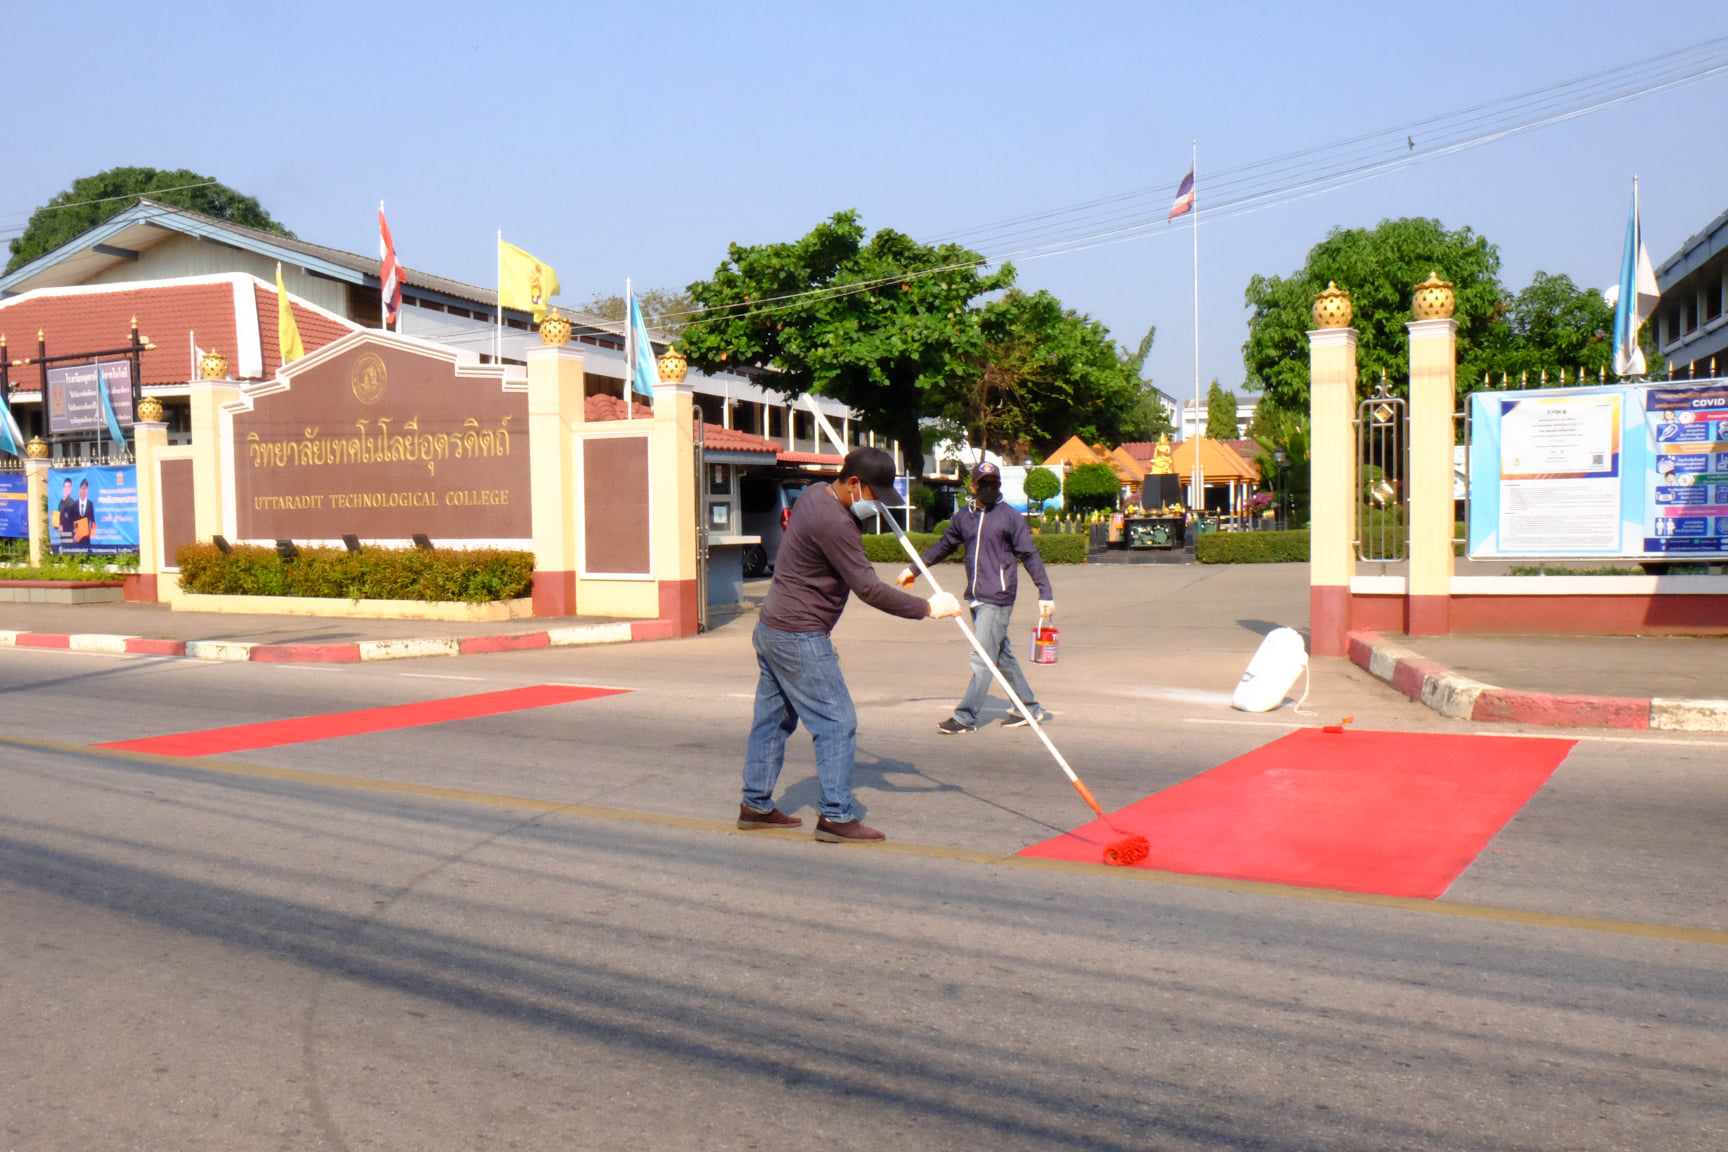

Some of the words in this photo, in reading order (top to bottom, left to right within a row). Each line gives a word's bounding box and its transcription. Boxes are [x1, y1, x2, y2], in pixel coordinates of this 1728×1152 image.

[1692, 398, 1725, 407] COVID
[247, 414, 512, 477] วิทยาลัยเทคโนโลยีอุตรดิตถ์
[254, 495, 324, 510] UTTARADIT
[329, 492, 439, 509] TECHNOLOGICAL
[445, 490, 509, 506] COLLEGE
